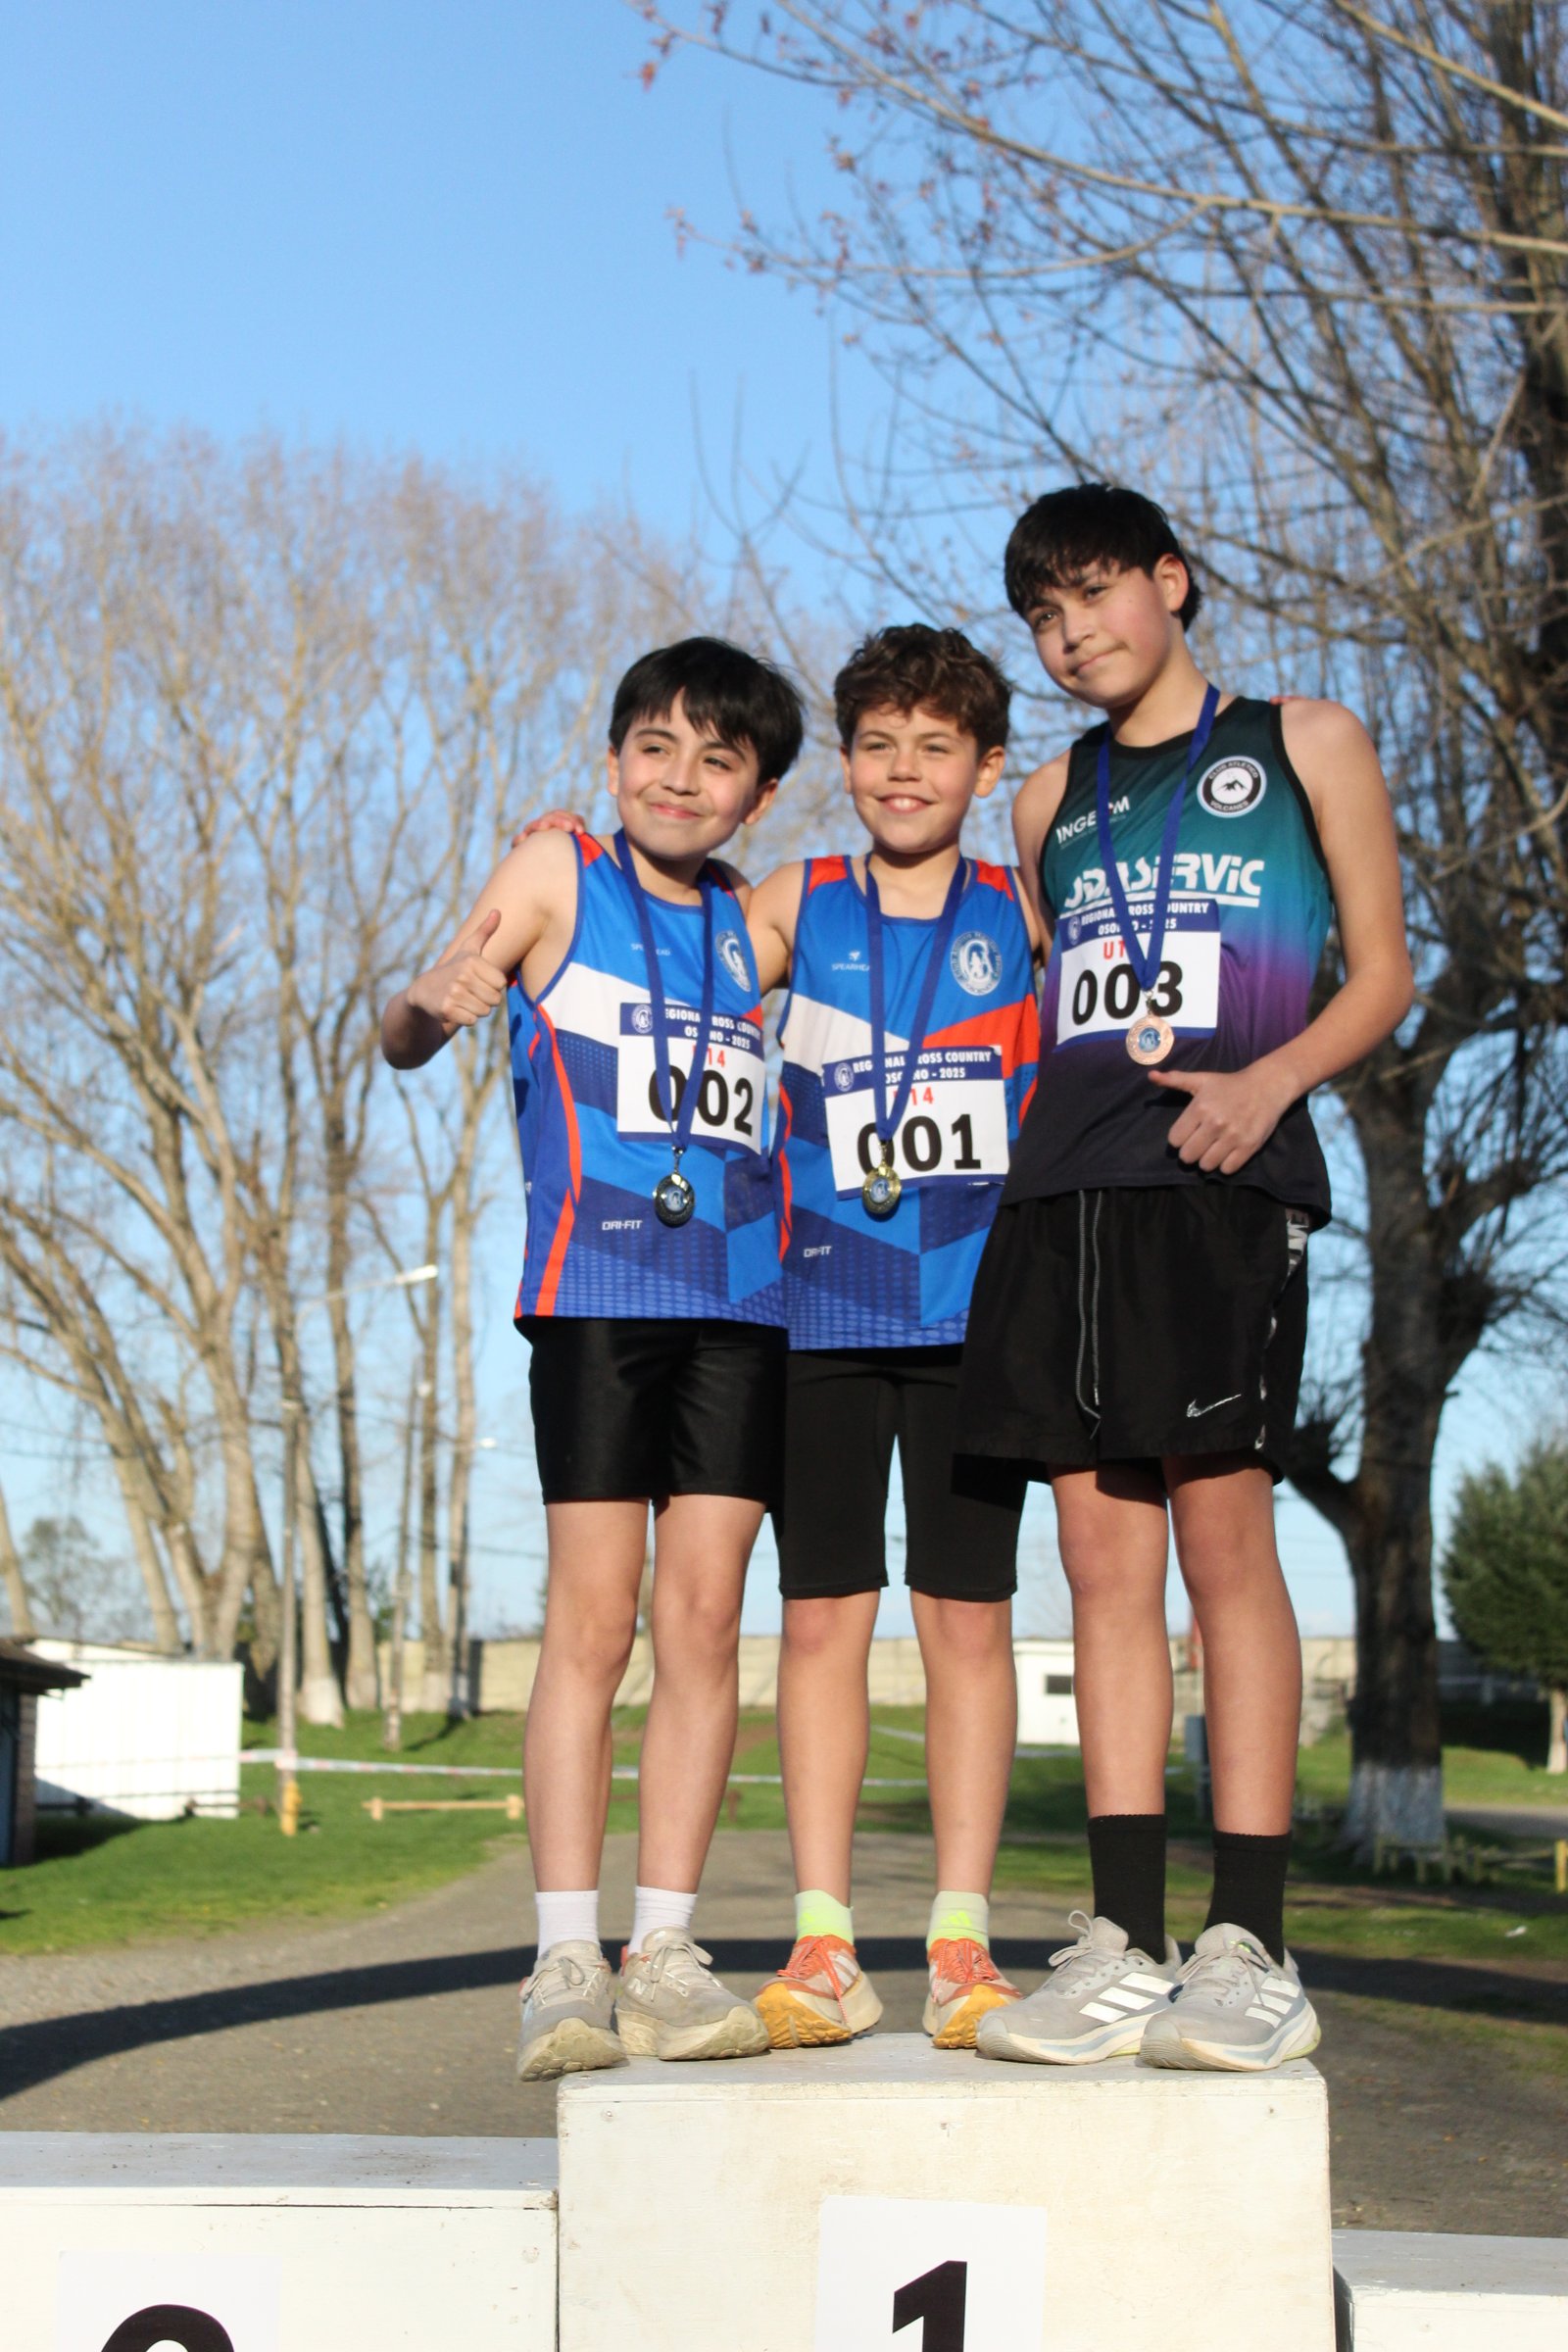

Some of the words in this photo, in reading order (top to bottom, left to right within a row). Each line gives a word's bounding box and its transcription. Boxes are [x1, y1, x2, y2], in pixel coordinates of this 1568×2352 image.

[1055, 796, 1130, 844] INGEM
[1081, 907, 1116, 926] REGIONA
[1128, 904, 1154, 916] ROSS
[1103, 939, 1126, 960] U1
[1072, 960, 1183, 1026] 003
[711, 1015, 735, 1030] ROSS
[684, 1025, 724, 1043] OSNO
[693, 1045, 725, 1067] 14
[853, 1054, 906, 1074] REGNAL
[917, 1052, 943, 1066] ROSS
[945, 1052, 992, 1063] COUNTRY
[939, 1067, 966, 1079] 2025
[649, 1064, 754, 1138] 002
[893, 1086, 934, 1105] 14
[858, 1113, 982, 1177] 001
